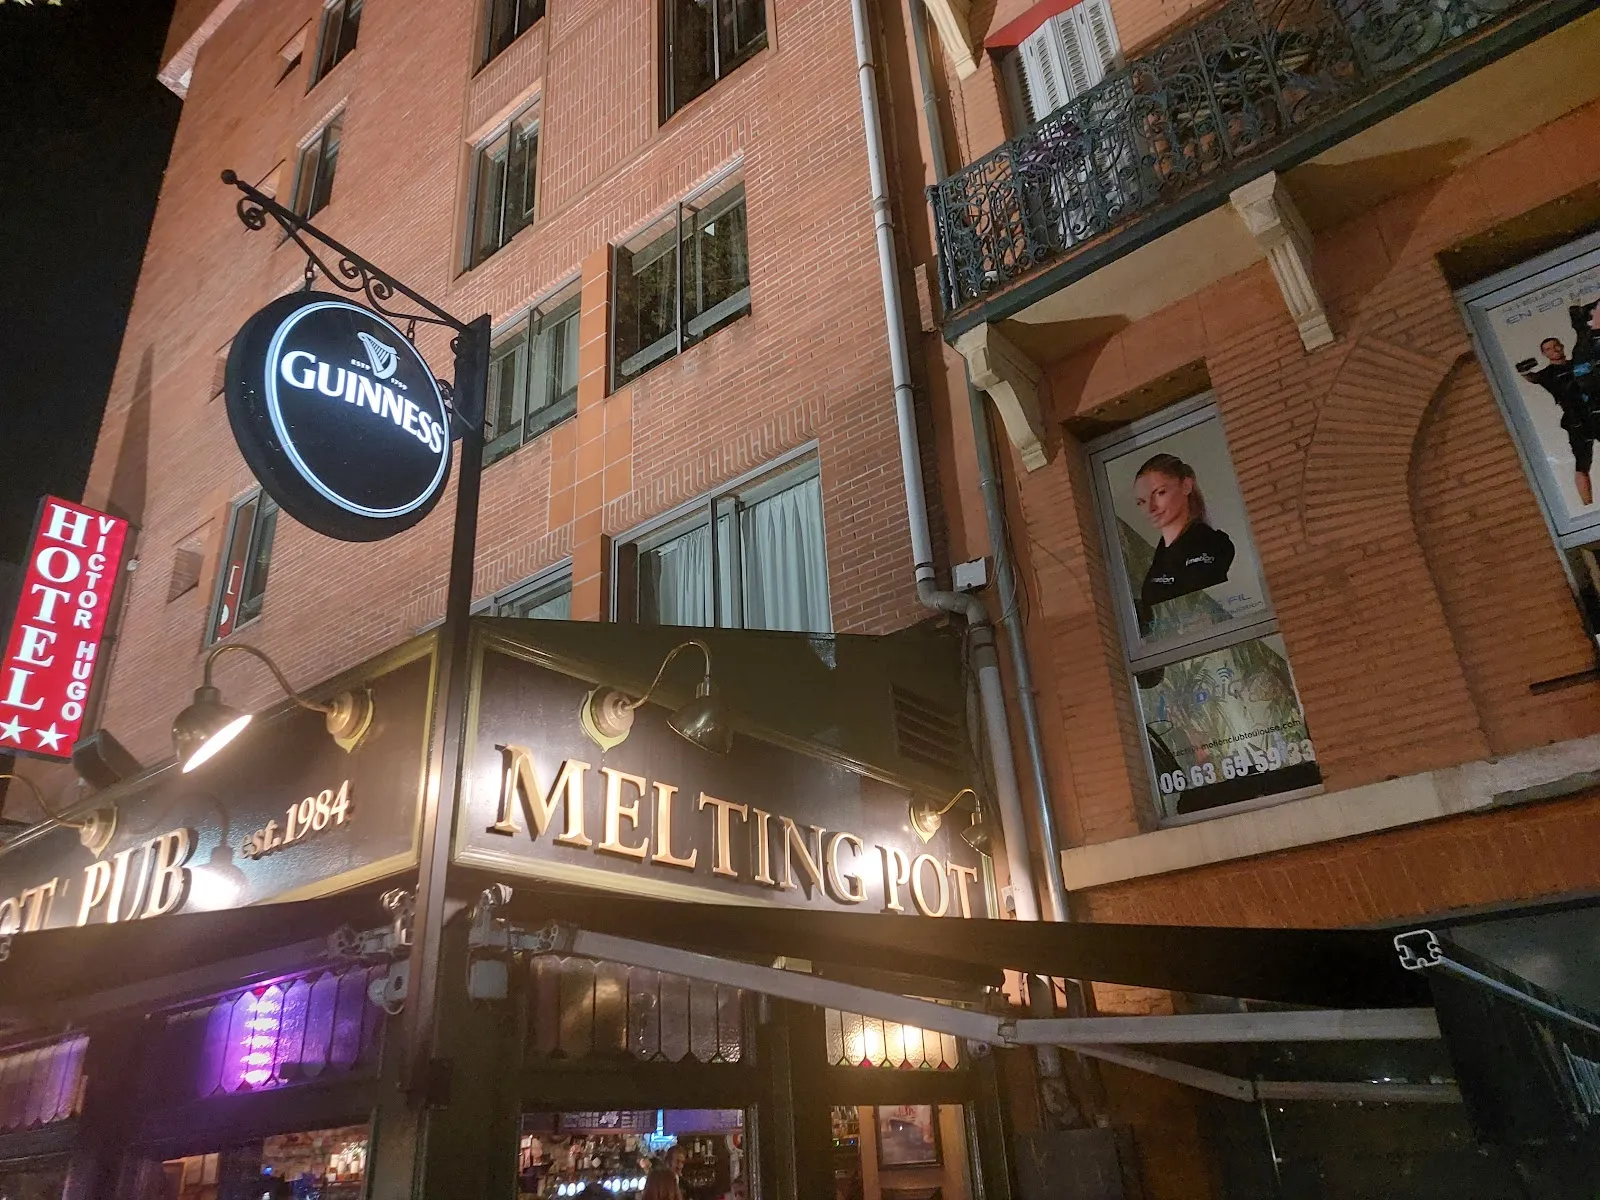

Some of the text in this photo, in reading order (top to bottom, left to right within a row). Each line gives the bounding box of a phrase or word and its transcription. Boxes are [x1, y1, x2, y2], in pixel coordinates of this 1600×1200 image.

[1506, 309, 1532, 325] EN
[281, 350, 444, 453] GUINNESS
[391, 377, 408, 390] 1759
[1, 503, 94, 711] HOTEL
[61, 515, 116, 721] VICTOR HUGO
[1160, 769, 1186, 794] 06
[1190, 762, 1216, 787] 63
[1253, 747, 1282, 771] 59
[1286, 738, 1316, 763] 33
[76, 827, 188, 927] PUB
[494, 743, 978, 918] MELTING POT
